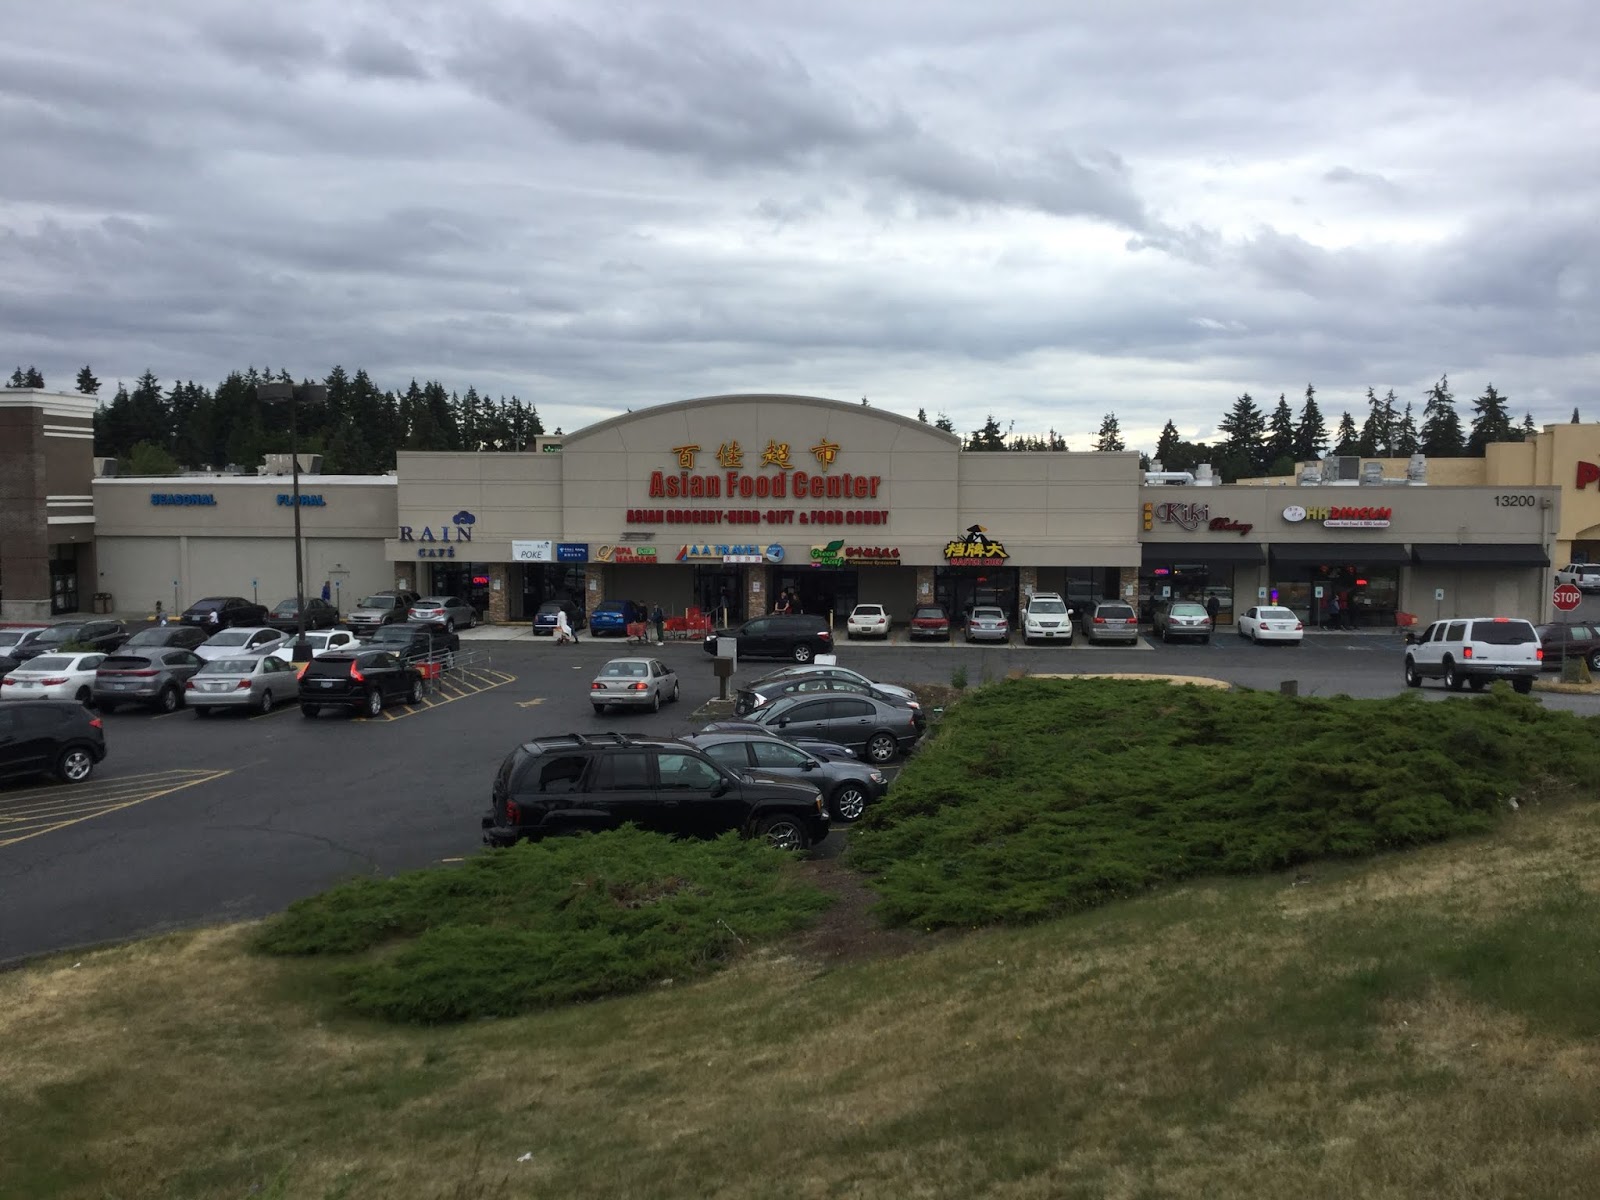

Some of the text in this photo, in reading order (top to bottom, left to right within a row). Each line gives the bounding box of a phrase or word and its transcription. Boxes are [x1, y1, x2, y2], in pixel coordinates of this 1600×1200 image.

[672, 439, 841, 472] 百佳超市
[1576, 460, 1600, 492] P
[649, 470, 881, 498] Asian Food Center
[151, 494, 217, 506] SEASONAL
[1494, 495, 1536, 507] 13200
[627, 509, 664, 524] ASIAN
[799, 512, 809, 524] &
[811, 510, 844, 524] FOOD
[846, 510, 889, 525] COURT
[1156, 502, 1209, 531] Kiki
[1306, 506, 1329, 520] HK
[399, 526, 473, 543] RAIN
[520, 550, 542, 559] POKE
[615, 547, 632, 555] SPA
[715, 544, 760, 555] TRAVEL
[811, 548, 838, 558] Green
[821, 557, 844, 567] Leaf
[1553, 592, 1579, 602] STOP
